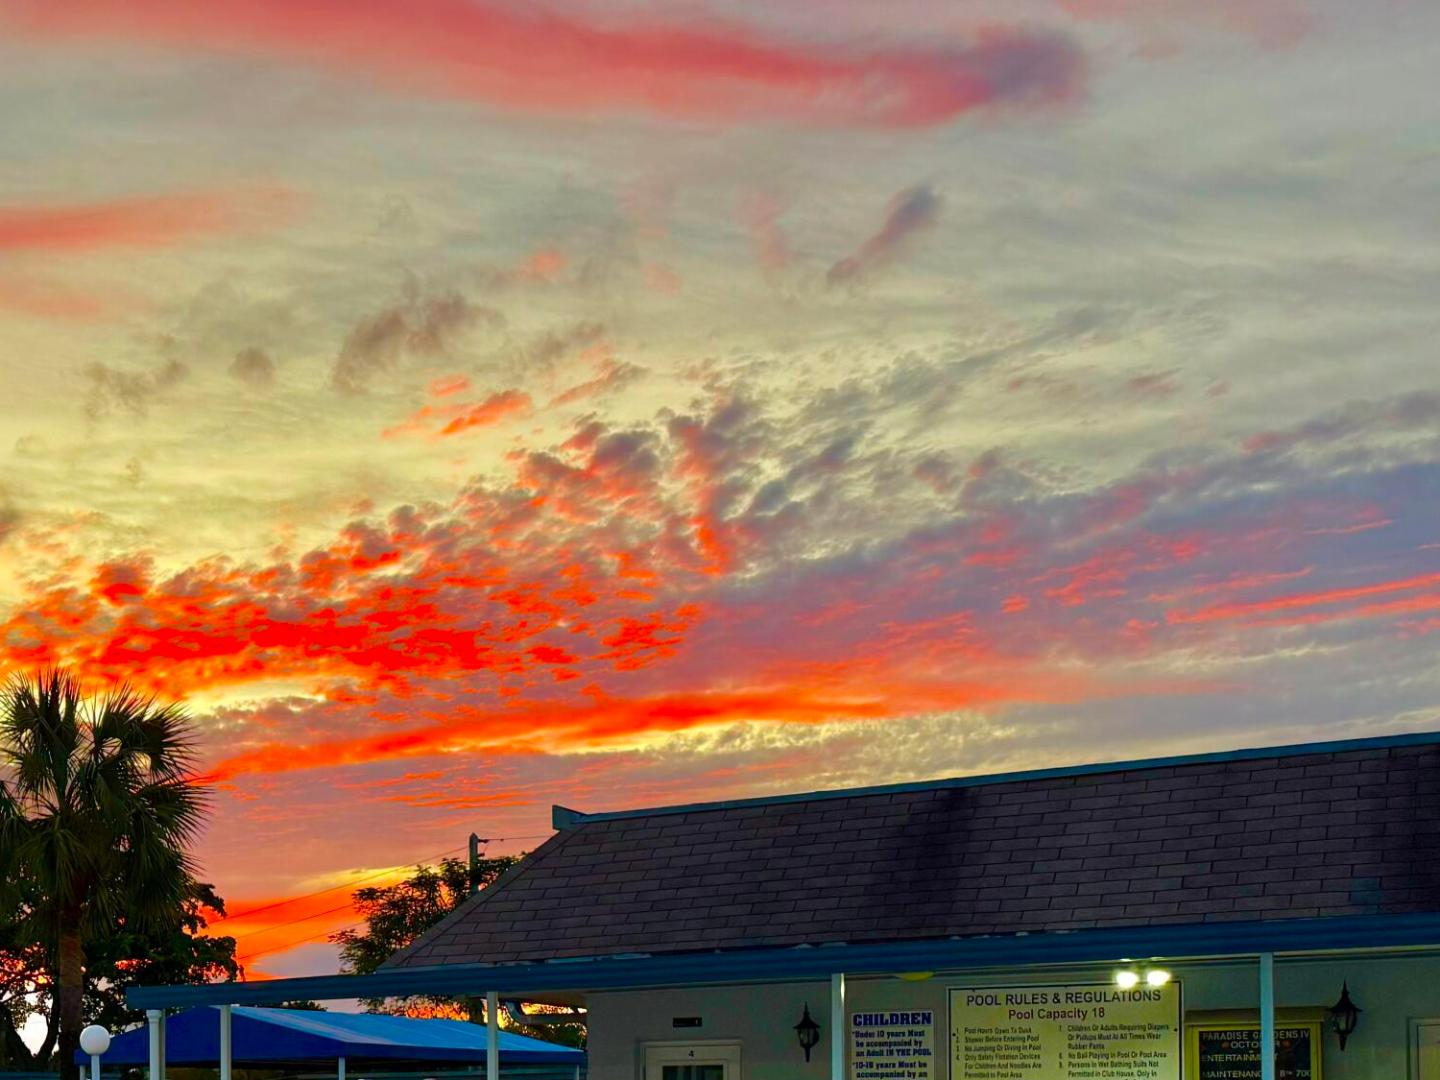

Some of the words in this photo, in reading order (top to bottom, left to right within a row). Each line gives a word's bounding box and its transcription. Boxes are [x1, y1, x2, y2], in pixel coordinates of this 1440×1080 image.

[967, 995, 1001, 1006] POOL
[1006, 994, 1048, 1004] RULES
[1053, 993, 1060, 1004] &
[1066, 990, 1161, 1003] REGULATIONS
[1009, 1009, 1034, 1019] Pool
[1038, 1008, 1088, 1021] Capacity
[1093, 1007, 1104, 1018] 18
[853, 1013, 931, 1026] CHILDREN
[1202, 1032, 1248, 1040] PARADISE
[1252, 1030, 1298, 1040] GDENS
[866, 1040, 911, 1048] accompanied
[914, 1039, 922, 1048] by
[1202, 1054, 1278, 1062] ENTERTAINMT
[907, 1070, 916, 1079] by
[1202, 1070, 1262, 1078] MAINTENANC
